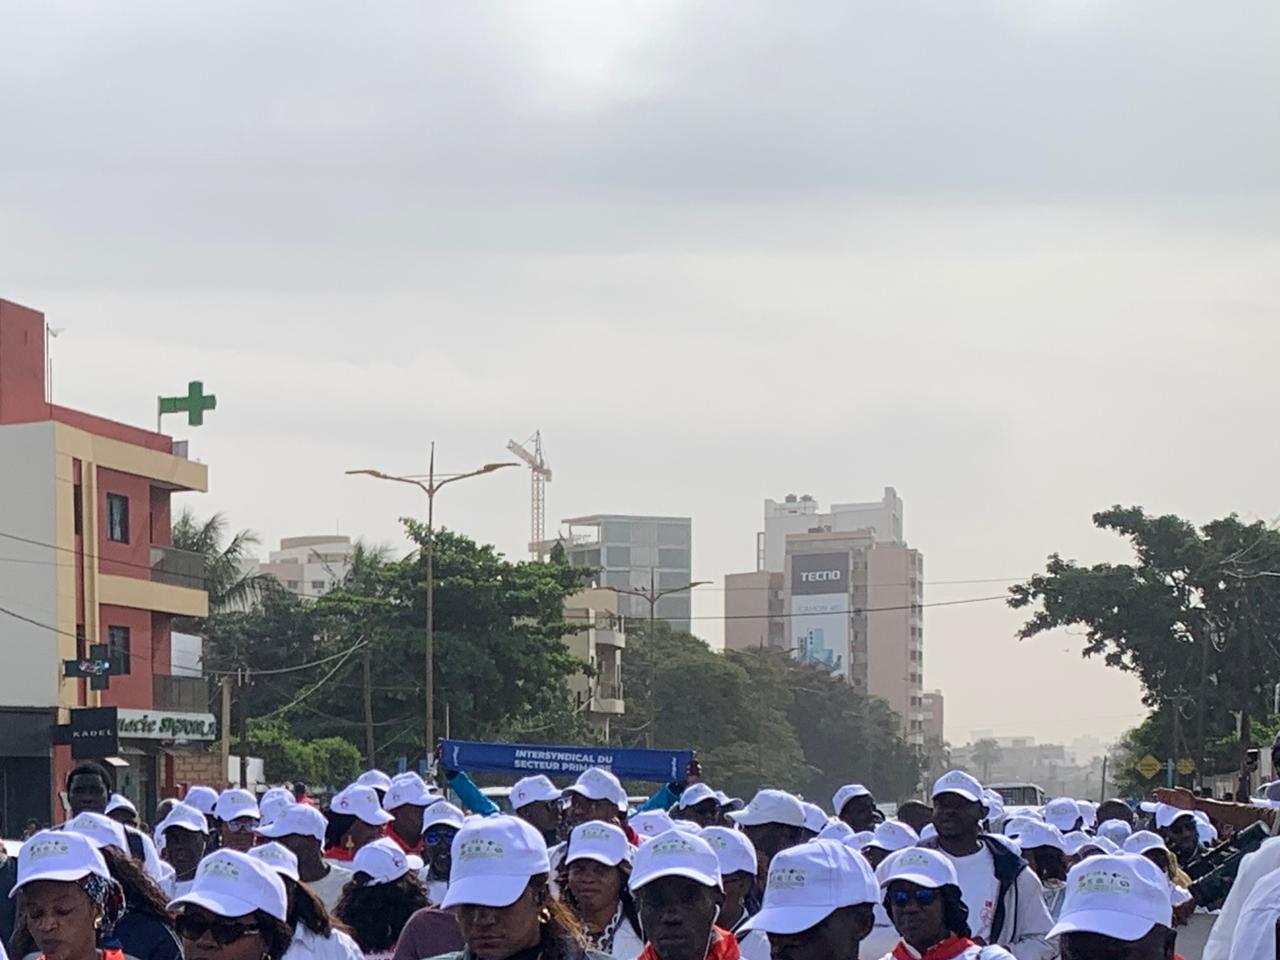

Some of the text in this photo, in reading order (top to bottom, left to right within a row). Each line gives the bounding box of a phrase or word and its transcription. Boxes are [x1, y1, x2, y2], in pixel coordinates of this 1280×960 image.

[800, 570, 840, 581] TECNO
[72, 729, 113, 738] KADEL
[515, 750, 613, 764] INTERSYNDICAL DU
[514, 760, 560, 771] SECTEUR
